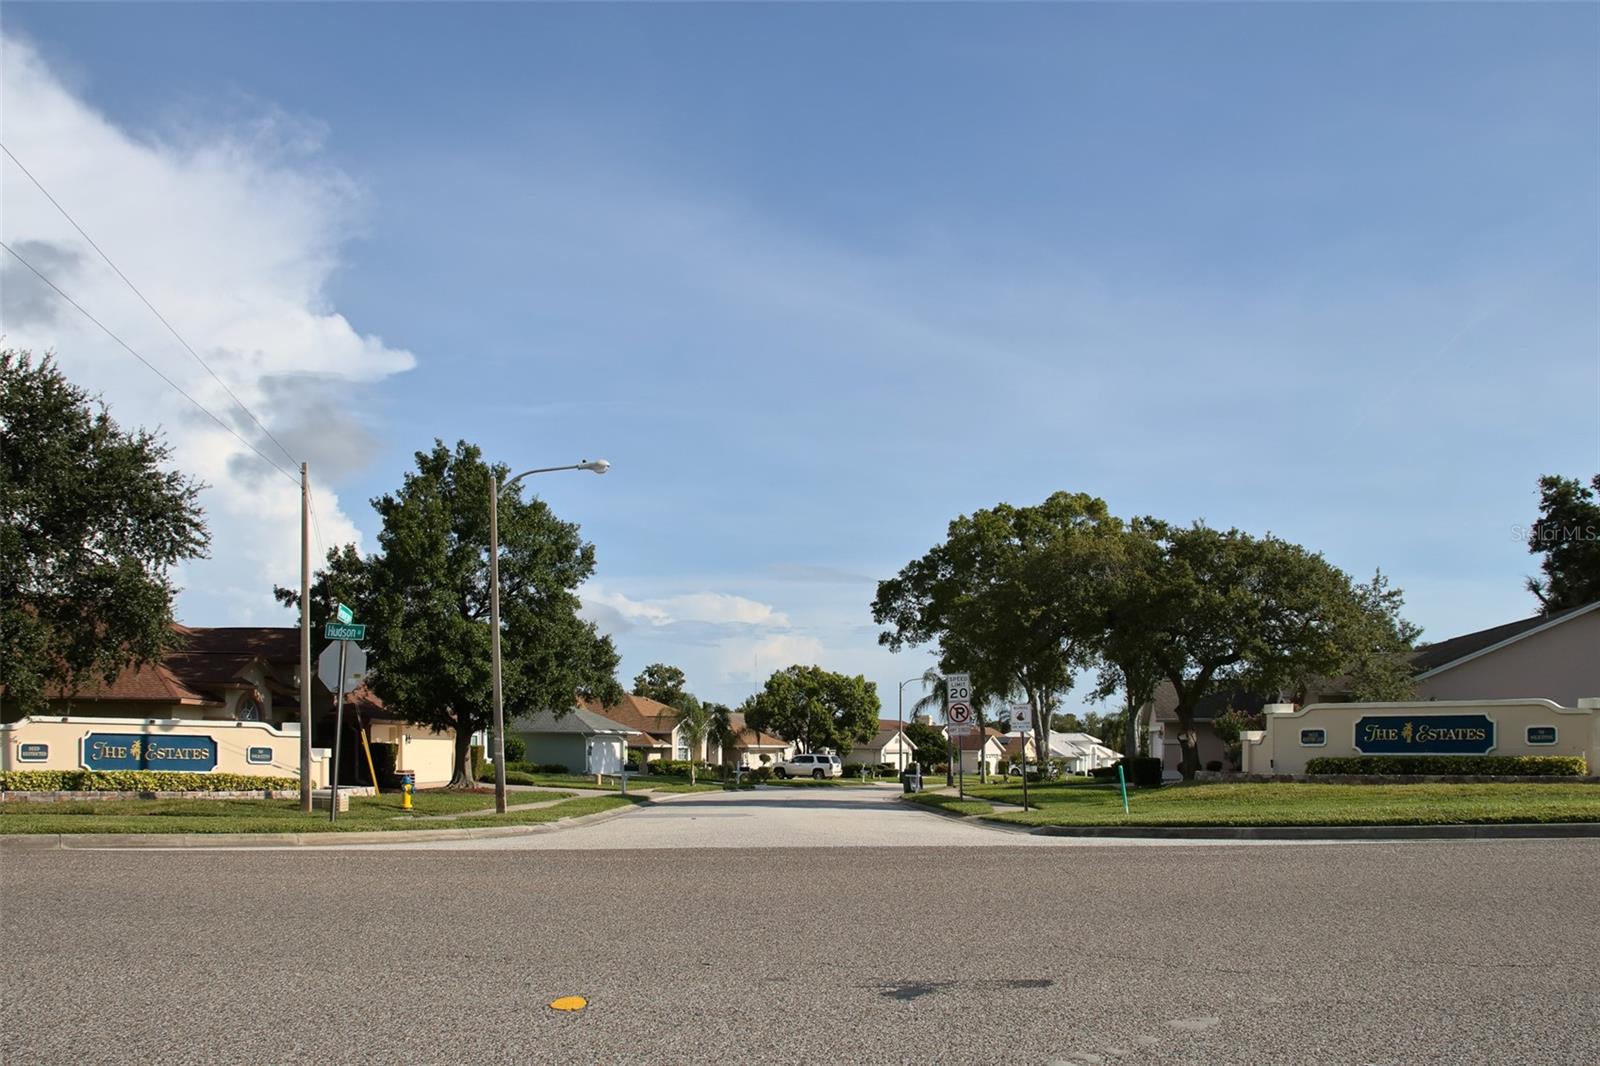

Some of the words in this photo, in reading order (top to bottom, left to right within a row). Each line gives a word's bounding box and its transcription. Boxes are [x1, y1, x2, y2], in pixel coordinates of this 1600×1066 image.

[327, 625, 357, 638] Hudson
[950, 688, 968, 698] 20
[1364, 724, 1398, 741] THE
[1416, 725, 1486, 742] ESTATES
[92, 741, 127, 760] THE
[144, 743, 210, 761] ESTATES
